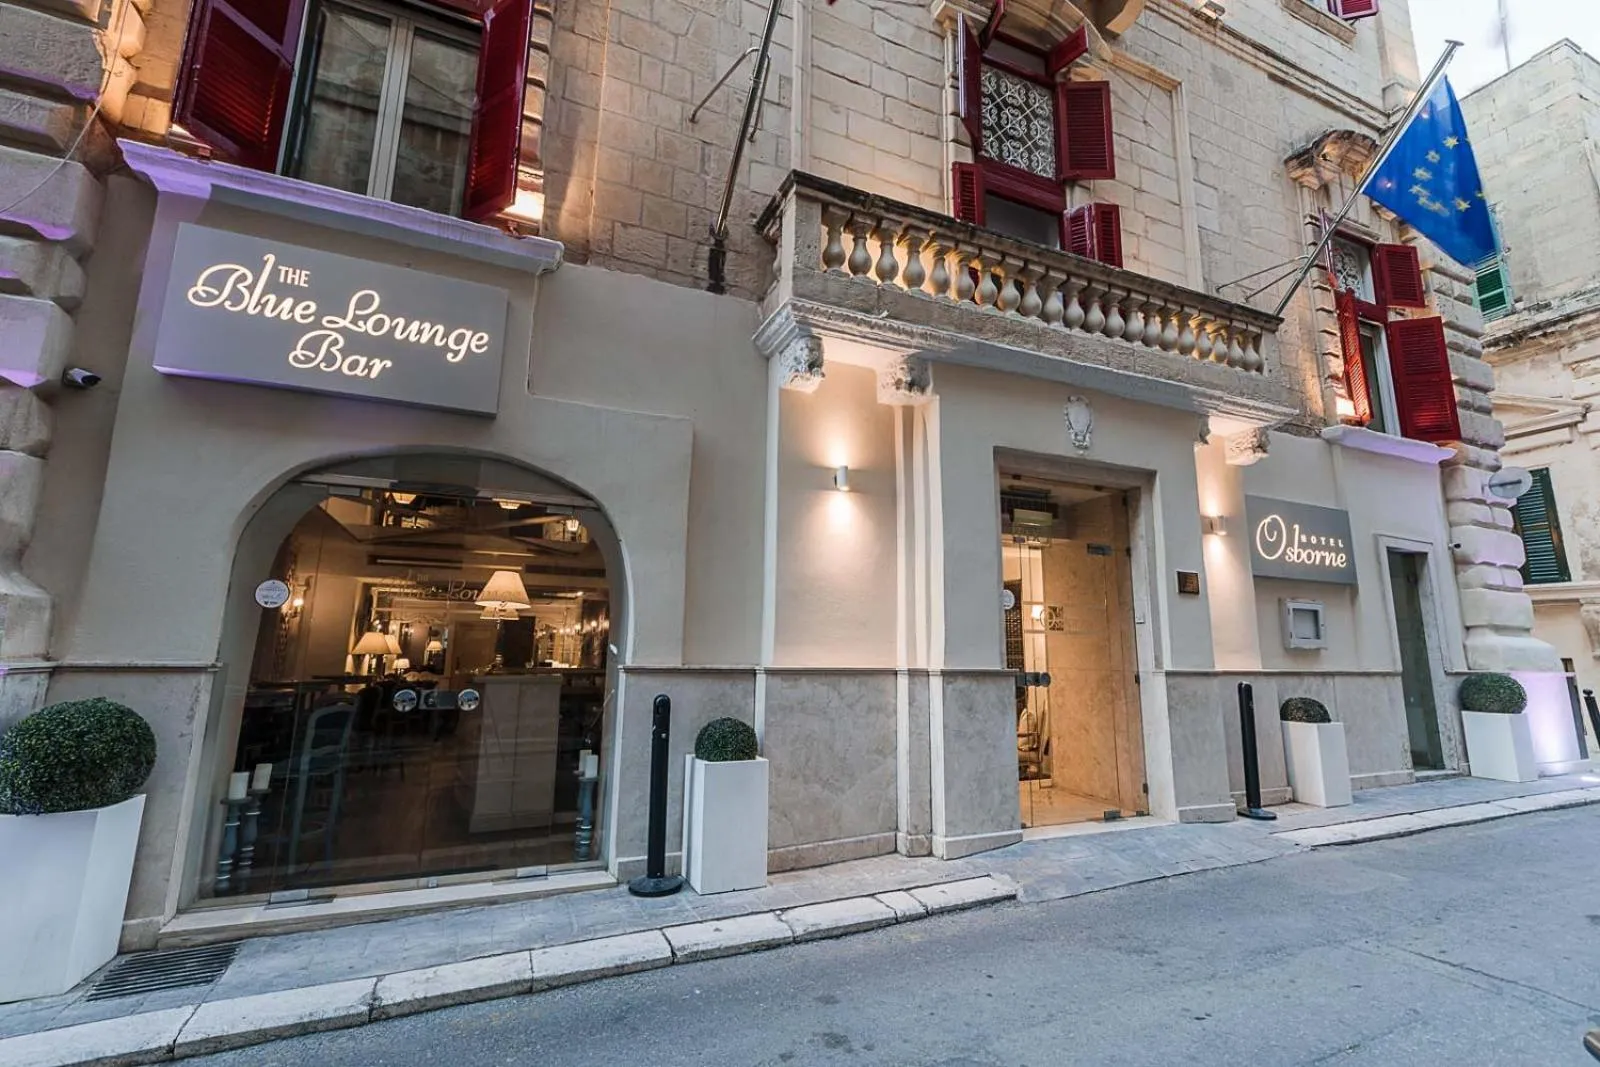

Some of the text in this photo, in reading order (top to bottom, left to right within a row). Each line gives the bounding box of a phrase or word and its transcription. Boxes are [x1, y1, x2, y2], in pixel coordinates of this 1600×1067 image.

[277, 265, 311, 288] THE
[187, 253, 490, 363] Blue Lounge
[288, 329, 393, 379] Bar
[1255, 514, 1347, 568] Osborne
[1300, 533, 1344, 548] HOTEL
